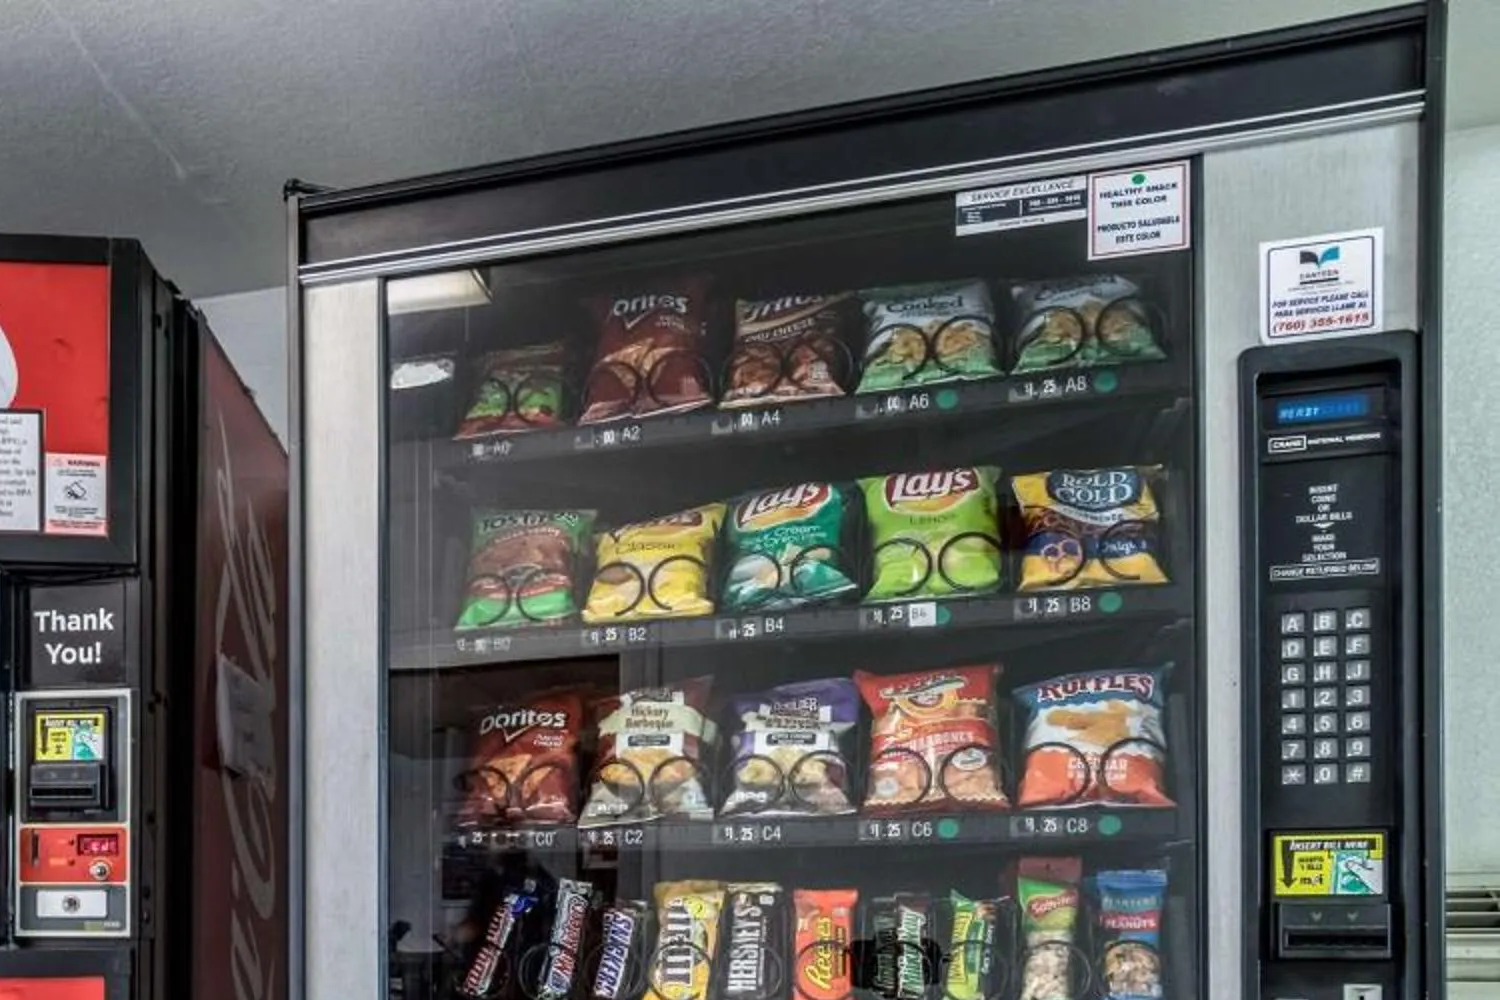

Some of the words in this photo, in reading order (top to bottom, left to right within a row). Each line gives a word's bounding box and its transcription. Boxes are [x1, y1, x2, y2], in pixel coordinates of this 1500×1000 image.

[1100, 187, 1143, 199] HEALTHY
[1145, 182, 1178, 193] SNACK
[1111, 200, 1131, 209] THIS
[1134, 195, 1167, 205] COLOR
[1097, 221, 1136, 232] PRODUCTO
[1115, 234, 1134, 244] ESTE
[1135, 231, 1161, 242] COLOR
[1289, 296, 1318, 306] SERVICE
[1273, 320, 1305, 333] (760)
[1066, 376, 1087, 393] A8
[909, 393, 929, 409] A6
[761, 410, 781, 426] A4
[622, 426, 642, 442] A2
[892, 470, 973, 501] Lay's
[1062, 471, 1128, 488] ROLD
[1055, 483, 1133, 503] GOLD
[1295, 513, 1328, 524] DOLLAR
[1329, 511, 1353, 521] BILLS
[1070, 596, 1091, 613] B8
[33, 608, 114, 632] Thank
[765, 616, 784, 634] B4
[1287, 617, 1299, 632] A
[1319, 615, 1330, 629] B
[1351, 612, 1364, 628] C
[629, 627, 646, 642] B2
[44, 642, 102, 664] You!
[1287, 641, 1299, 656] D
[1319, 640, 1331, 655] E
[1352, 639, 1363, 653] F
[1287, 666, 1299, 681] G
[1319, 665, 1331, 680] H
[1353, 664, 1362, 679] J
[1037, 672, 1155, 703] RUFFLES
[1289, 693, 1296, 706] 1
[1319, 691, 1331, 705] 2
[1352, 690, 1363, 703] 3
[479, 708, 568, 736] Doritos
[1287, 717, 1297, 731] 4
[1319, 716, 1331, 730] 5
[1352, 715, 1363, 729] 6
[1288, 743, 1299, 756] 7
[1320, 741, 1331, 756] 8
[1352, 741, 1363, 755] 9
[1320, 767, 1331, 781] 0
[762, 825, 781, 841] C4
[912, 821, 932, 837] C6
[1067, 817, 1088, 834] C8
[625, 830, 643, 844] C2
[1104, 918, 1156, 930] PEANUTS
[727, 893, 762, 991] HERSHEY'S
